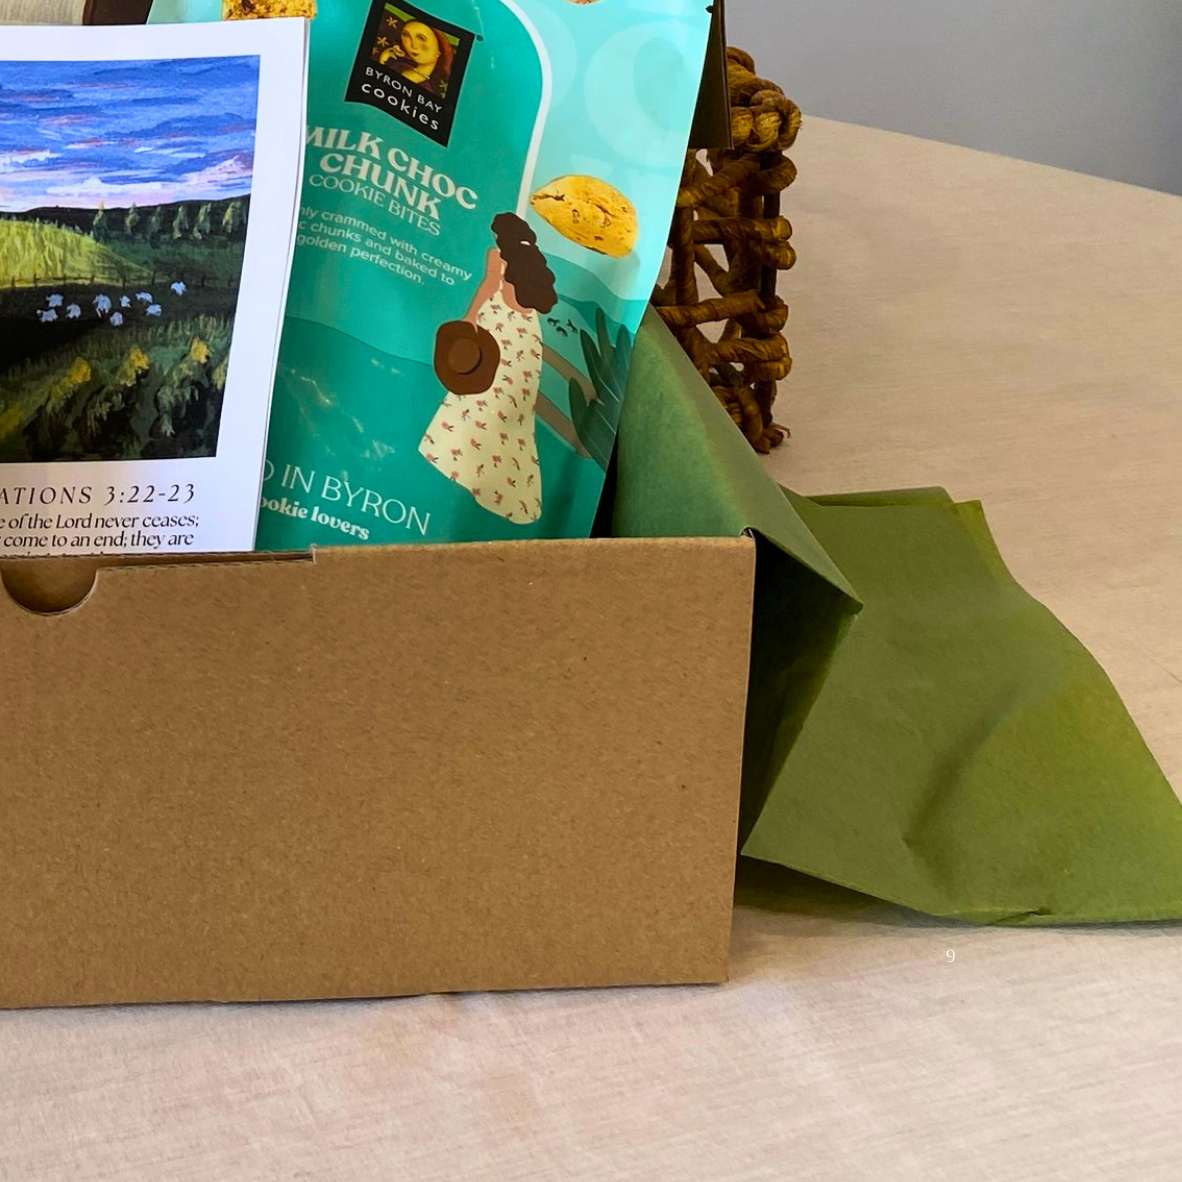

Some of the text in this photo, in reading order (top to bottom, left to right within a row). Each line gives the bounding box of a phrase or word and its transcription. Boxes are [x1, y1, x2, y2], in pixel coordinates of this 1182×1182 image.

[361, 83, 439, 130] cookies
[365, 66, 442, 113] BYRON BAY
[319, 153, 442, 221] CHUNK
[388, 147, 478, 210] CHOC
[309, 173, 441, 236] COOKIE BITES
[297, 234, 425, 285] golden perfection.
[311, 222, 362, 242] chunks
[365, 238, 392, 256] and
[395, 251, 437, 278] baked
[441, 273, 455, 285] to
[321, 211, 387, 240] crammed
[390, 235, 418, 256] with
[421, 252, 473, 281] creamy
[8, 513, 29, 529] of
[28, 513, 53, 529] the
[56, 512, 93, 529] Lord
[94, 516, 140, 528] never
[142, 515, 199, 528] ceases;
[103, 483, 195, 507] 3:22-23
[281, 464, 315, 493] IN
[321, 475, 431, 536] BYRON
[3, 536, 48, 547] come
[52, 534, 67, 547] to
[70, 536, 91, 547] an
[94, 530, 128, 549] end;
[130, 530, 166, 550] they
[168, 534, 195, 546] are
[311, 506, 369, 540] lovers
